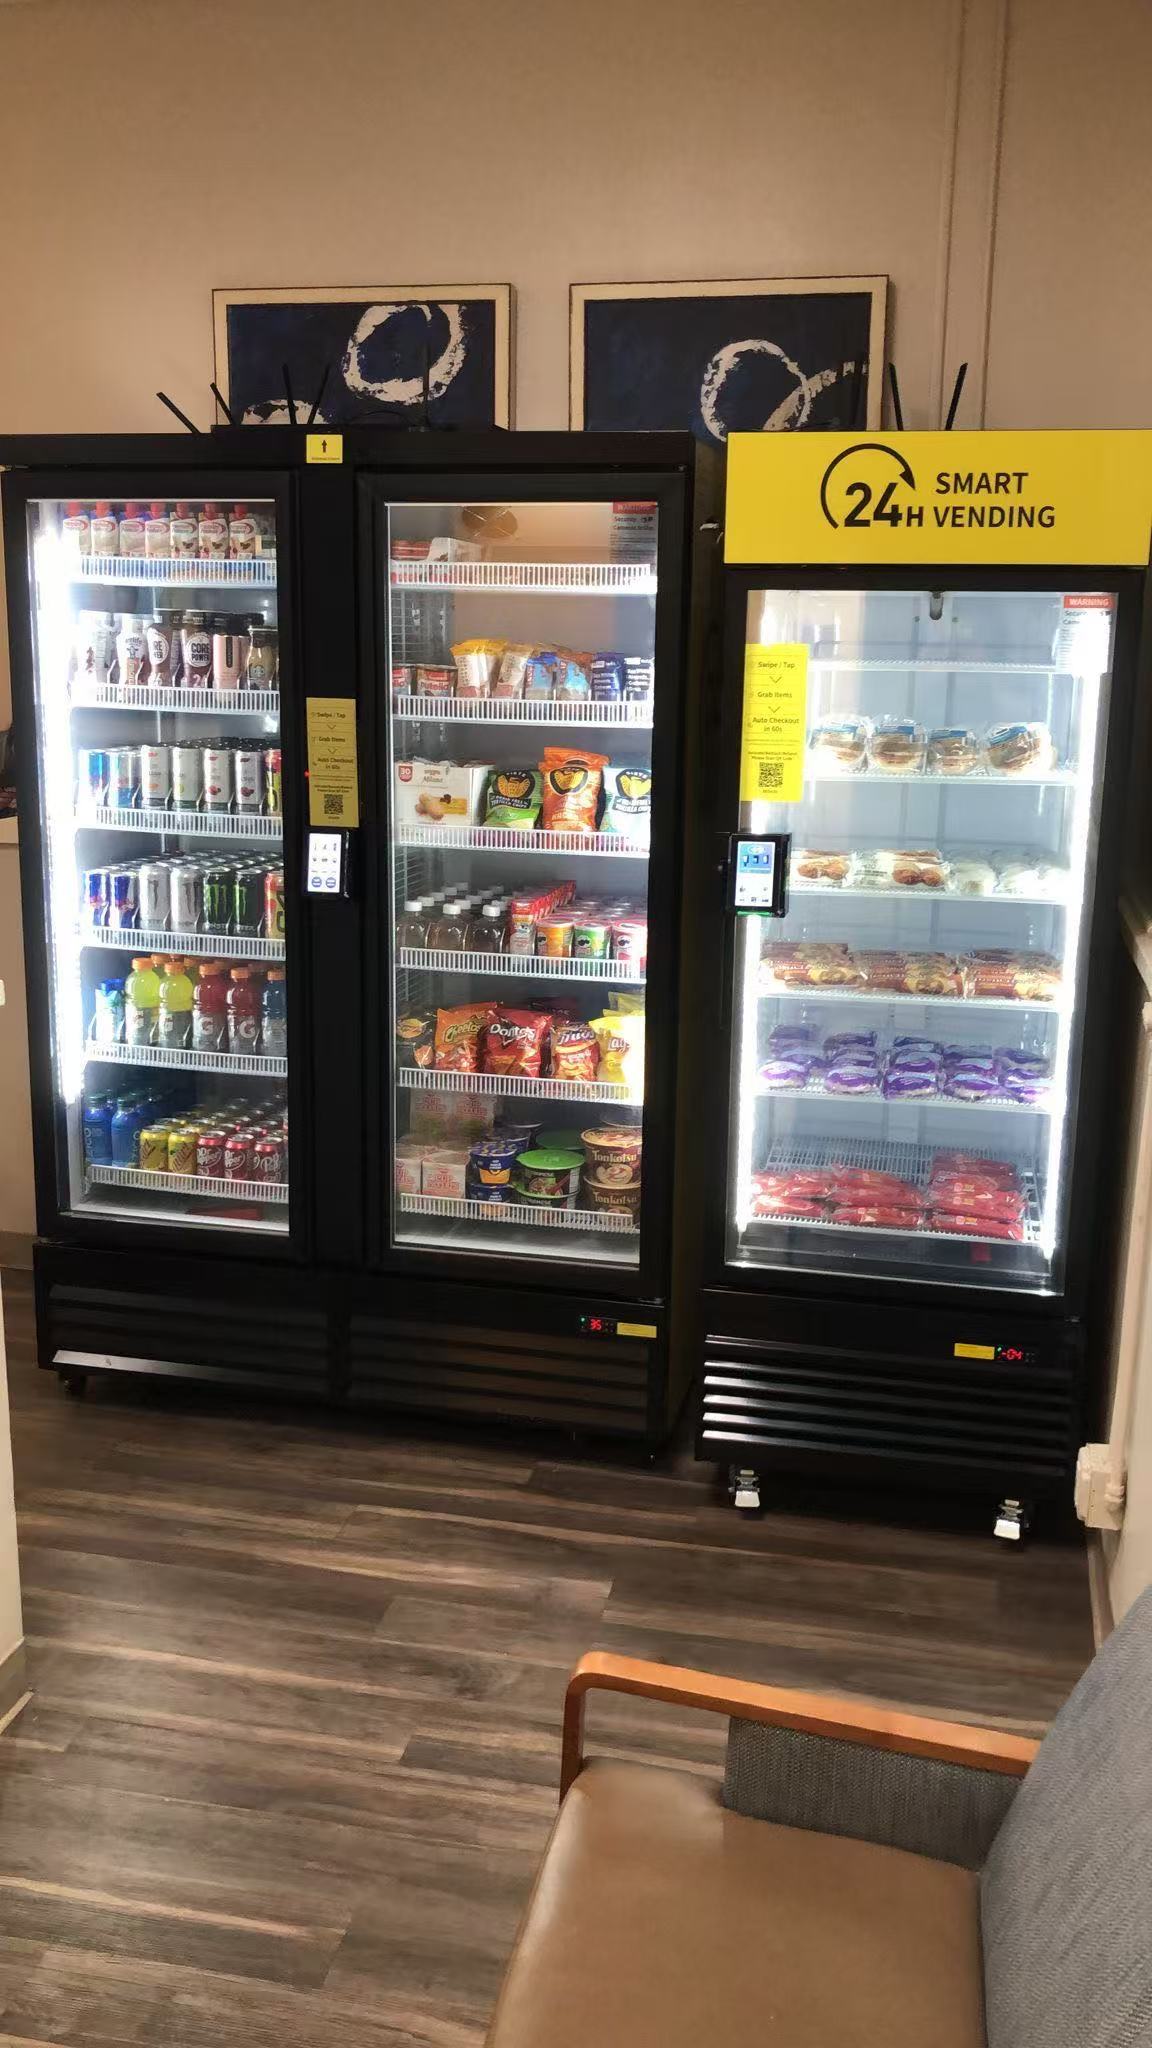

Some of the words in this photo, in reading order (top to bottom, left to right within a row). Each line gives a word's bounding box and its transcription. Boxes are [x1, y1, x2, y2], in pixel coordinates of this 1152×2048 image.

[935, 472, 1029, 494] SMART
[933, 505, 1056, 528] VENDING
[191, 643, 210, 654] CORE
[191, 653, 210, 662] POWER
[758, 661, 778, 669] Swipe
[400, 767, 411, 775] 30
[239, 1019, 256, 1039] G
[489, 1023, 536, 1042] Doritos
[592, 1150, 637, 1163] Tonkotsu
[592, 1191, 637, 1205] Tonkotsu
